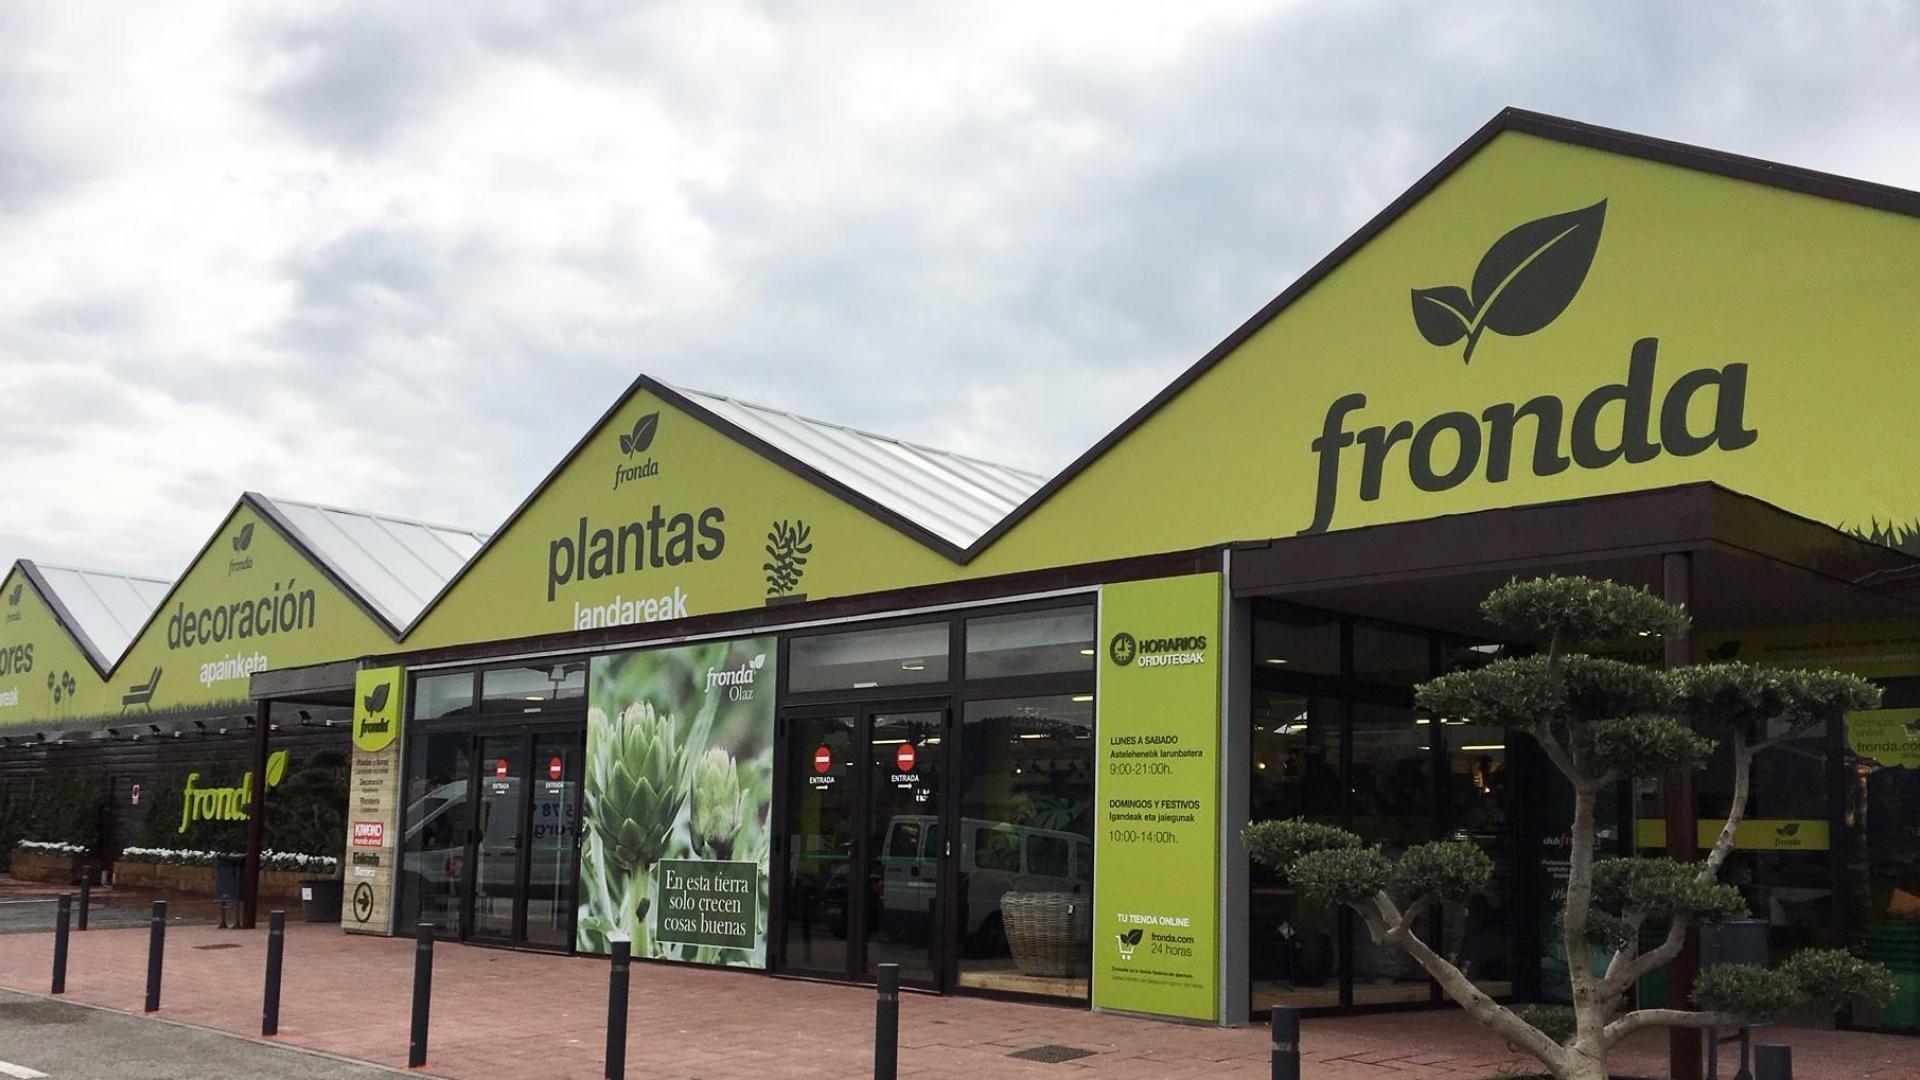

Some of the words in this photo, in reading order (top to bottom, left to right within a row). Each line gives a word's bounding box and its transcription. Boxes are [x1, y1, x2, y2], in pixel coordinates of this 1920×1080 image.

[1296, 337, 1758, 535] fronda
[613, 458, 660, 490] fronda
[548, 504, 726, 602] plantas
[228, 557, 254, 576] fronda
[168, 578, 316, 650] decoración
[574, 586, 689, 631] landareak
[1139, 635, 1207, 653] HORARIOS
[1138, 652, 1205, 668] ORDUTEGIAK
[200, 651, 268, 688] apainketa
[705, 663, 754, 693] fronda
[729, 684, 754, 701] Olaz
[359, 717, 390, 738] fronda
[1110, 736, 1137, 746] LUNES
[1137, 736, 1144, 745] A
[1145, 735, 1179, 745] SABADO
[1857, 741, 1920, 752] fronda.co
[1110, 750, 1159, 759] Astelehenatik
[1160, 748, 1203, 758] larunbatera
[1109, 762, 1173, 776] 9:00-21:00h.
[809, 776, 836, 785] ENTRADA
[891, 774, 921, 783] ENTRADA
[178, 772, 253, 834] frond
[1109, 799, 1153, 809] DOMINGOS
[1154, 800, 1160, 809] Y
[1161, 800, 1200, 810] FESTIVOS
[1109, 811, 1143, 822] Igandeak
[1144, 813, 1157, 822] eta
[1157, 812, 1195, 823] jaiegunak
[1109, 830, 1179, 844] 10:00-14:00h.
[665, 870, 684, 890] En
[686, 873, 711, 890] esta
[713, 872, 749, 893] tierra
[668, 889, 695, 910] solo
[698, 896, 741, 913] crecen
[664, 914, 697, 932] cosas
[700, 913, 746, 936] buenas
[1117, 913, 1128, 923] TU
[1129, 914, 1159, 925] TIENDA
[1159, 916, 1190, 927] ONLINE
[1151, 933, 1195, 944] fronda.com
[1151, 943, 1165, 955] 24
[1165, 943, 1193, 957] horas
